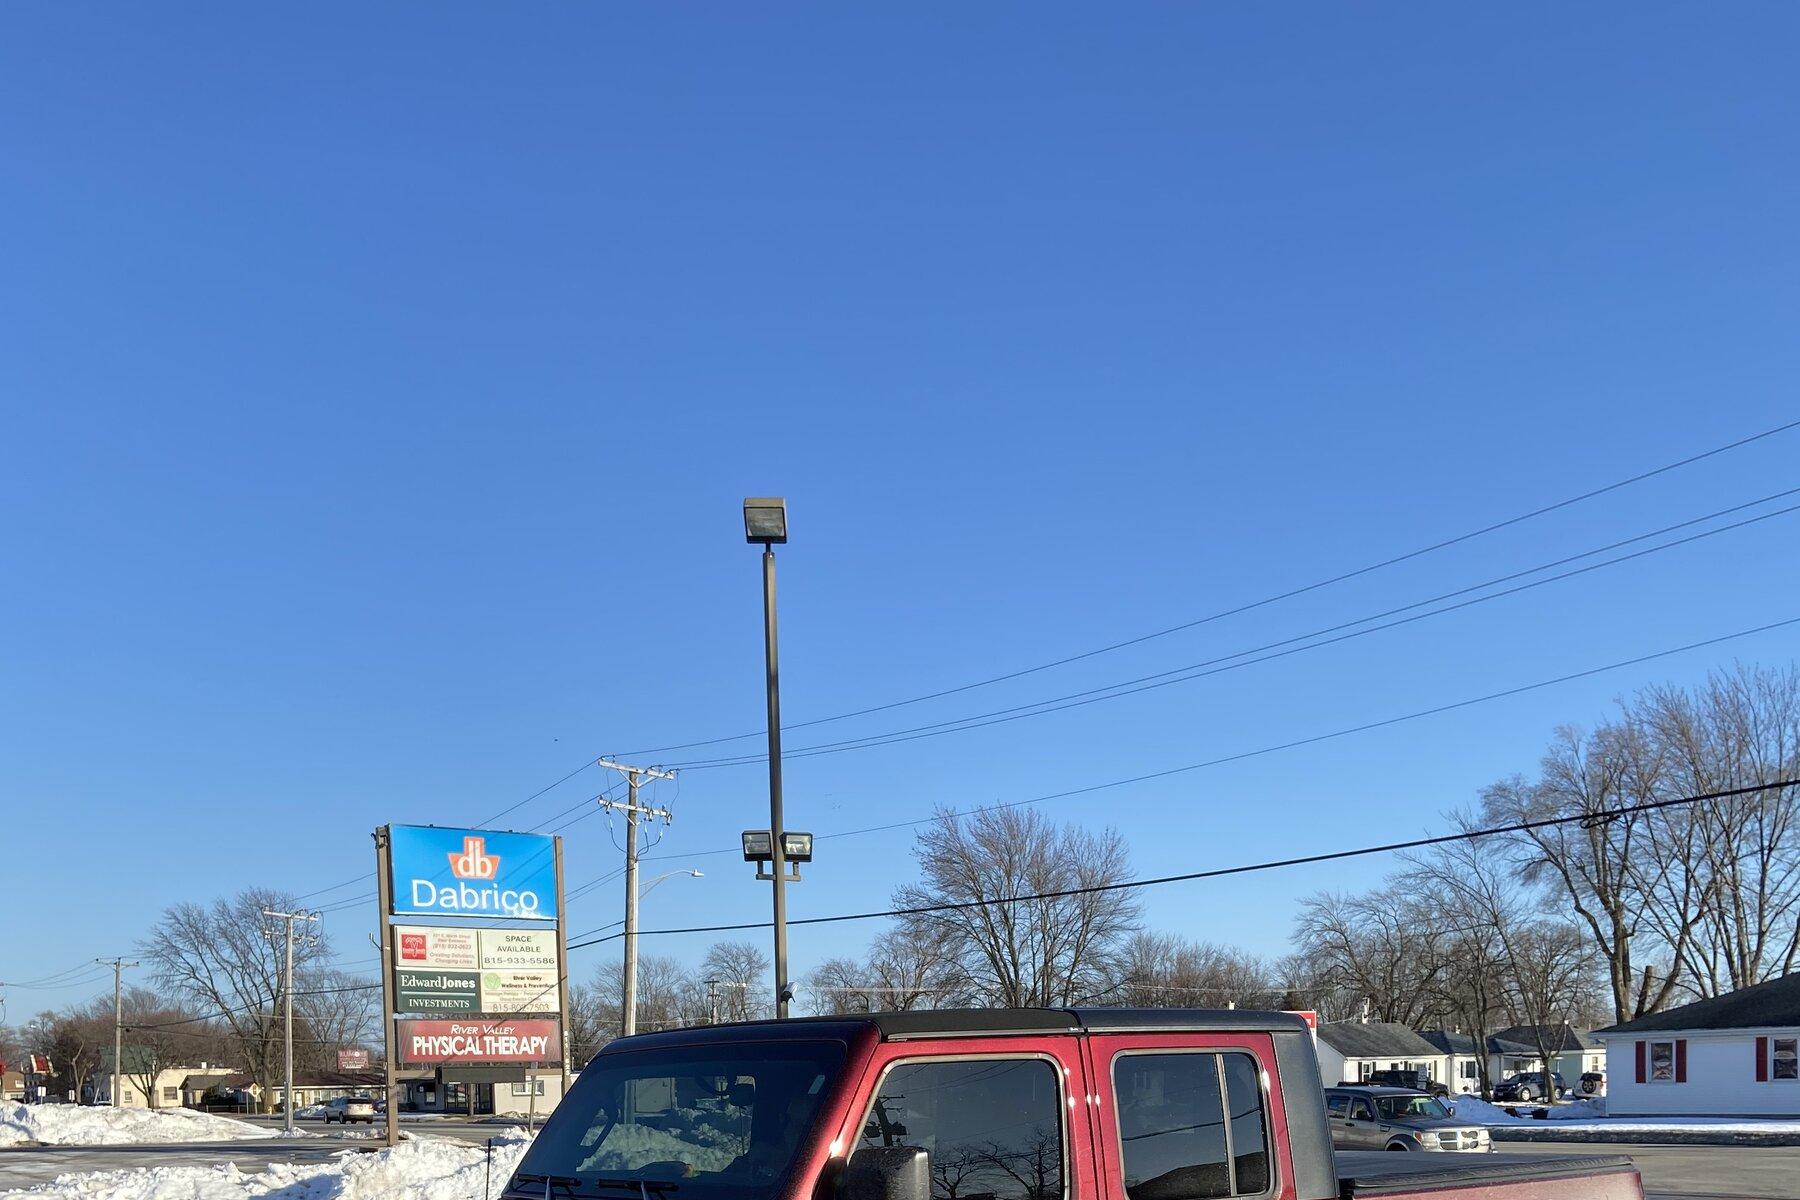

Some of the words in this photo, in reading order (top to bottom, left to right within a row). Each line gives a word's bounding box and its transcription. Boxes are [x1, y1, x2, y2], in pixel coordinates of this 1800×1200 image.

[411, 879, 539, 911] Dabrico
[497, 945, 542, 953] AVAILABLE
[484, 956, 555, 965] 815-933-5586
[409, 998, 470, 1008] INVESTMENTS
[450, 1024, 479, 1034] RIVER
[482, 1024, 515, 1035] VALLEY
[412, 1035, 483, 1056] PHYSICAL
[484, 1035, 548, 1056] THERAPY
